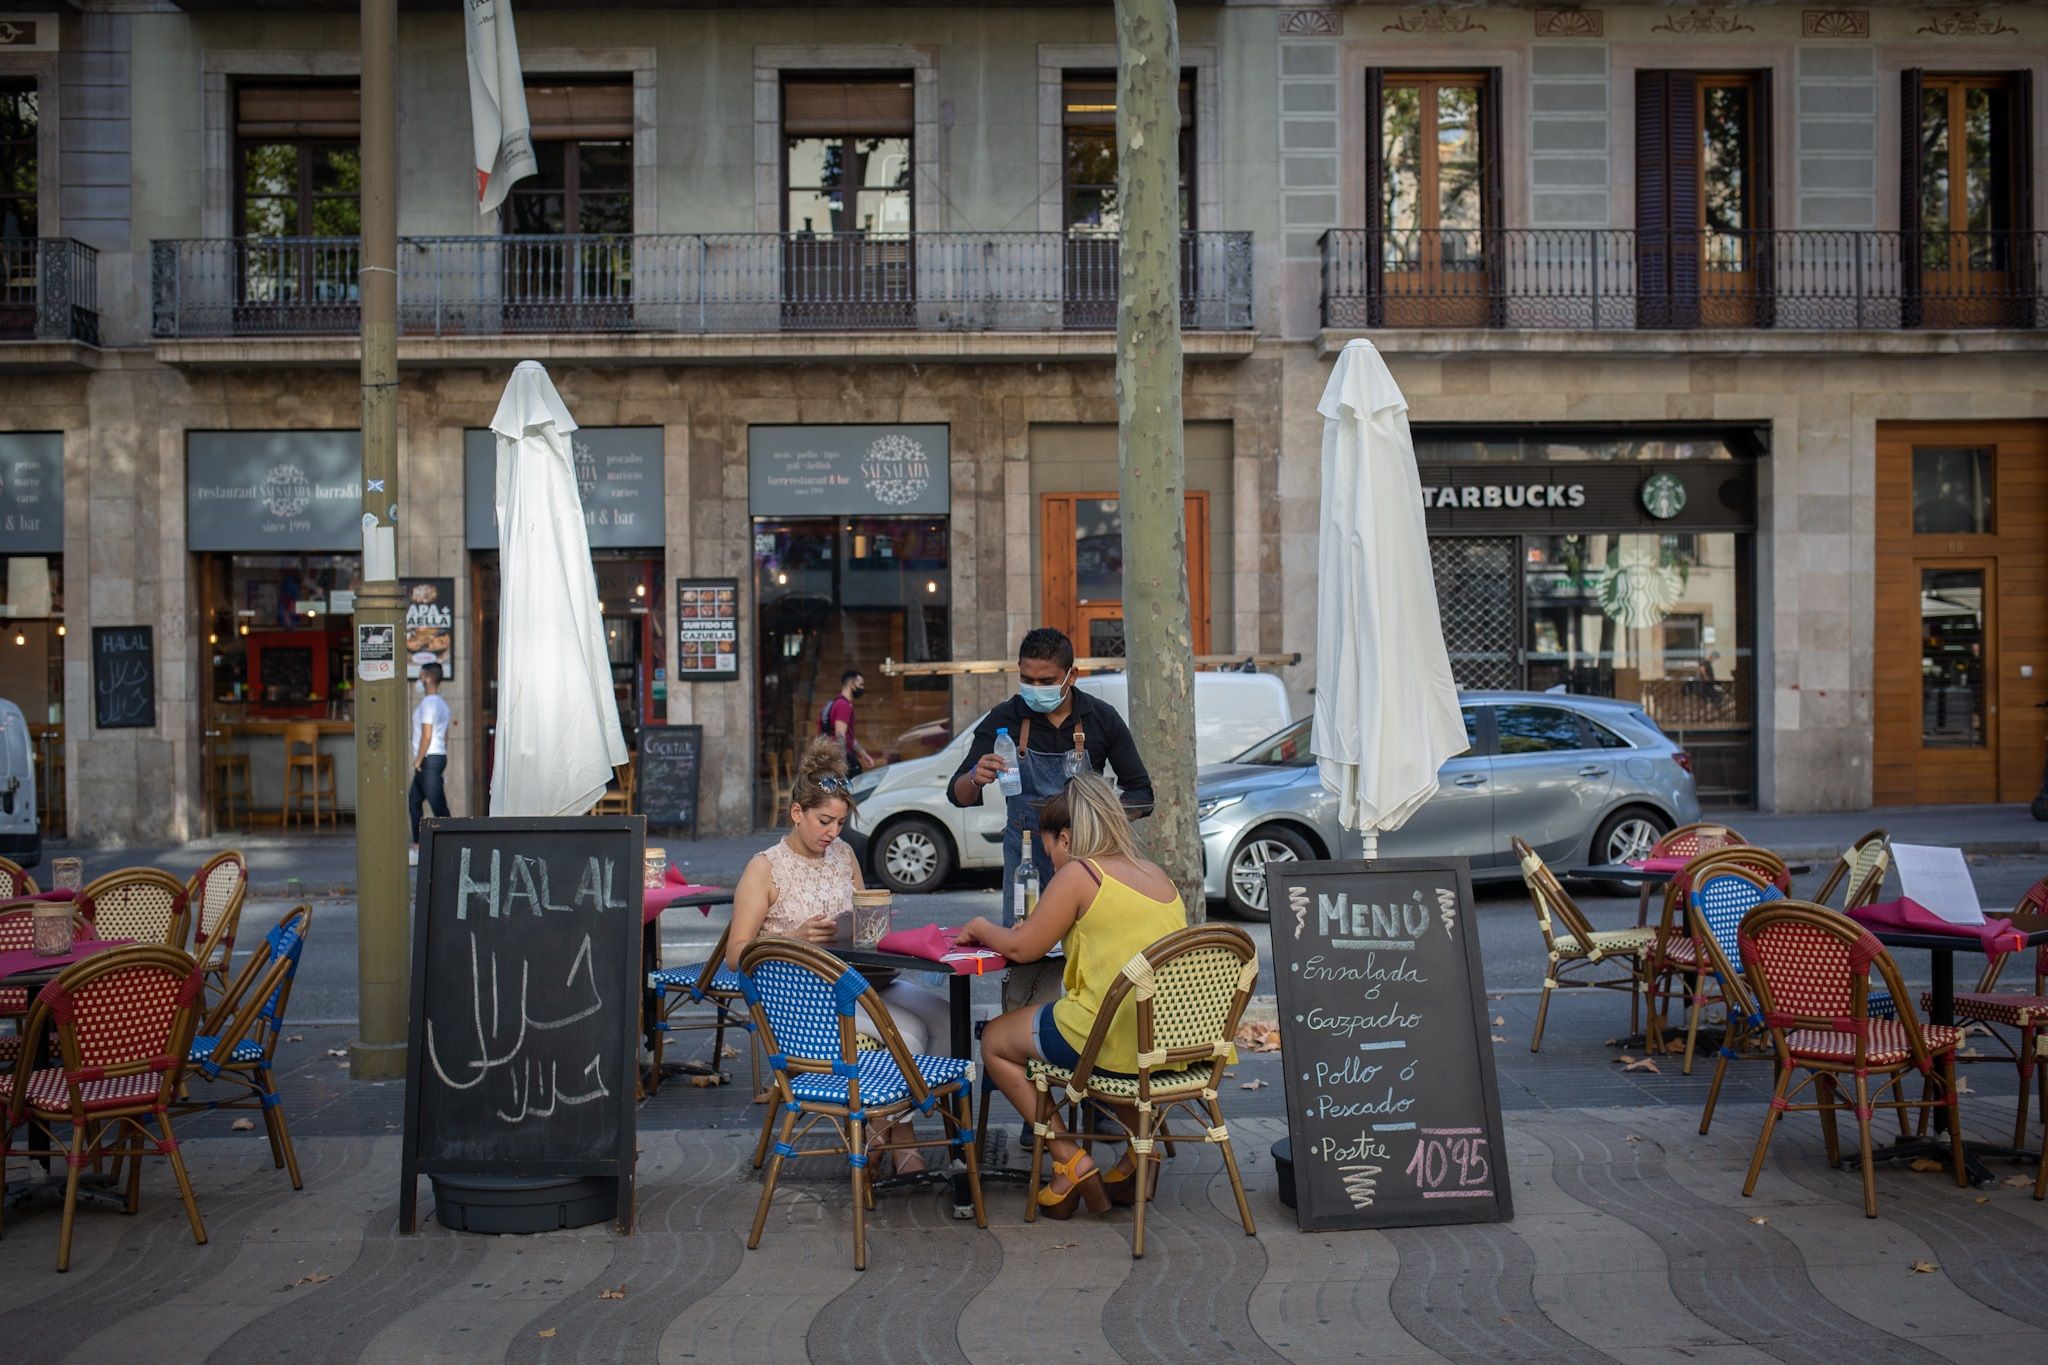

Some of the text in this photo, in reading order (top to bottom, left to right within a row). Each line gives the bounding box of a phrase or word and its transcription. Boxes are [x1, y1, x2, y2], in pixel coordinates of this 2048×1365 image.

[860, 463, 931, 479] SALSALADA
[198, 485, 257, 499] restaurant
[1422, 484, 1586, 508] TARBUCKS
[5, 514, 41, 532] & bar
[598, 509, 609, 525] &
[614, 508, 636, 525] bar
[407, 603, 440, 618] APA
[407, 617, 449, 627] AELLA
[682, 621, 734, 630] SURTIDO DE
[102, 633, 149, 653] HALAL
[682, 632, 734, 640] CAZUELAS
[456, 846, 629, 920] HALAL
[1302, 951, 1429, 984] Ensalada
[1364, 983, 1381, 1001] ó
[1306, 1001, 1423, 1036] Gazpacho
[1315, 1055, 1420, 1086] Pollo ó
[1318, 1086, 1415, 1120] Pescado
[1320, 1129, 1391, 1163] Postre
